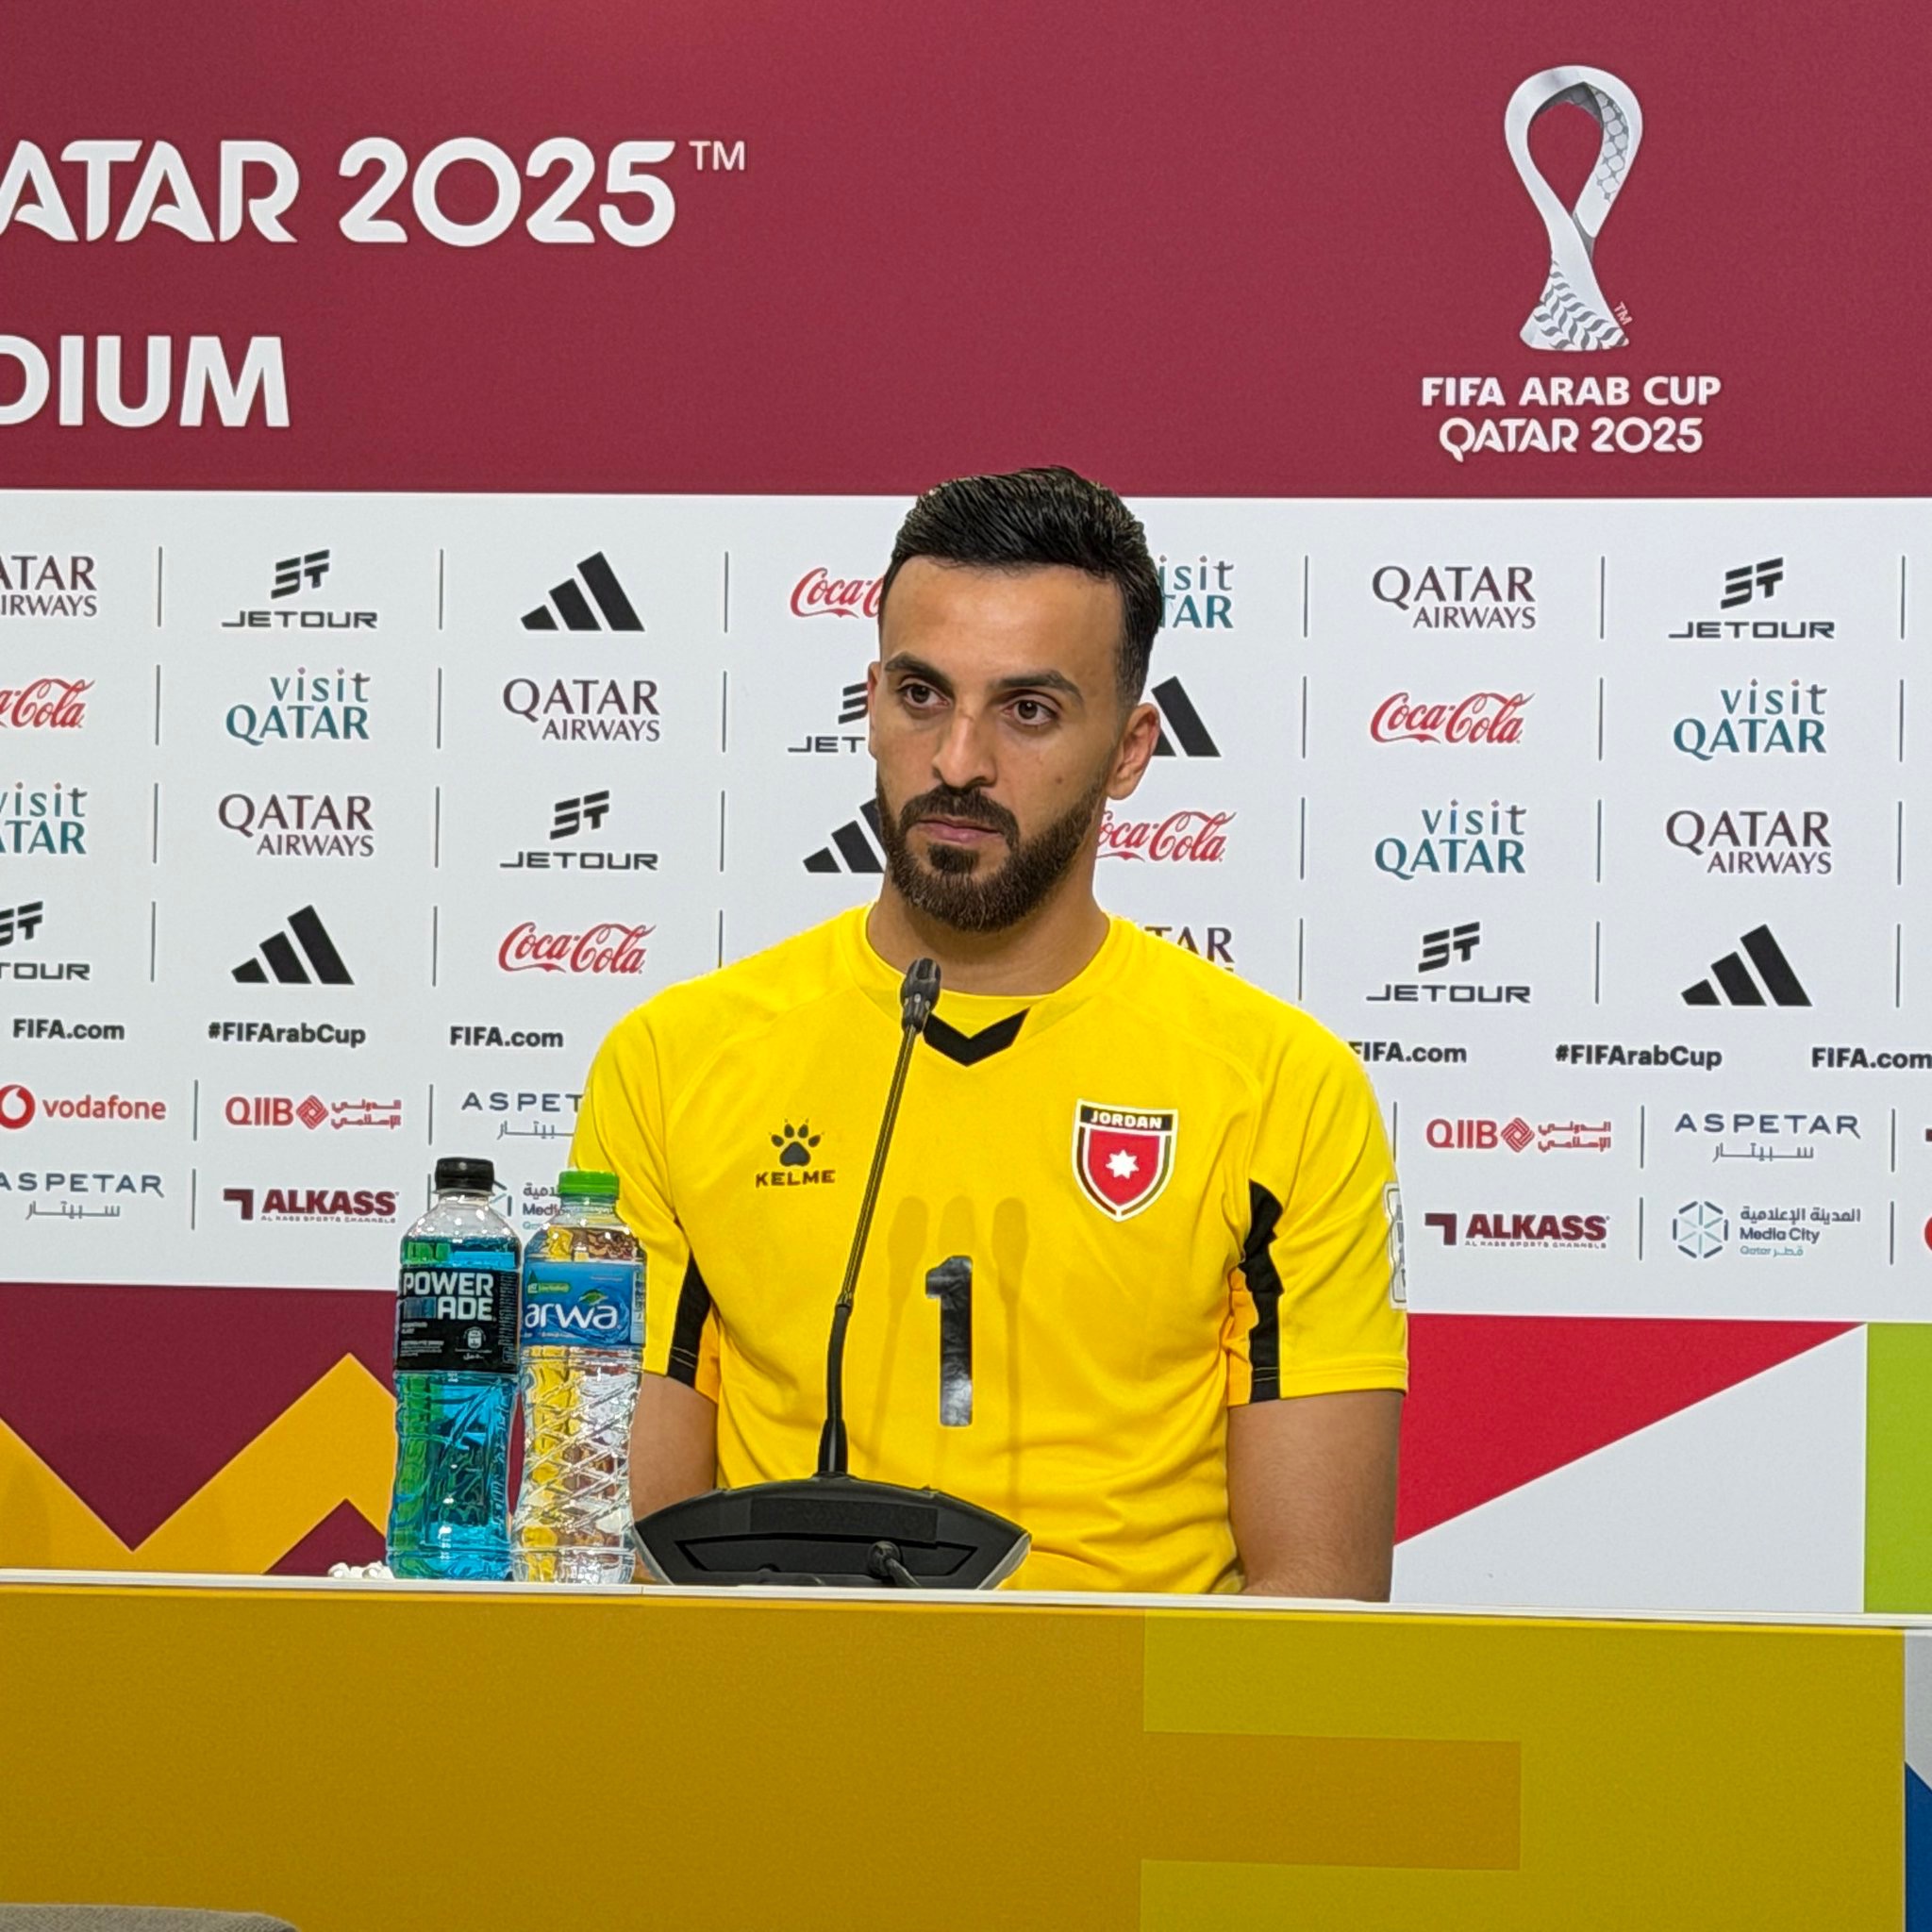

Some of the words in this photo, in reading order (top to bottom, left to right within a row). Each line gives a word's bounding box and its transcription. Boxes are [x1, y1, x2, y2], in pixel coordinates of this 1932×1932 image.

[1423, 377, 1506, 406] FIFA
[1519, 377, 1629, 406] ARAB
[1644, 376, 1721, 406] CUP
[1440, 418, 1578, 461] QATAR
[1591, 417, 1702, 453] 2025
[1158, 556, 1234, 591] isit
[1372, 565, 1536, 608] QATAR
[222, 611, 377, 628] JETOUR
[1412, 606, 1536, 629] AIRWAYS
[1669, 622, 1834, 639] JETOUR
[271, 668, 370, 702] visit
[1721, 679, 1826, 715] visit
[503, 678, 659, 722] QATAR
[226, 705, 368, 745] QATAR
[1371, 692, 1532, 743] Coca-Cola
[542, 721, 660, 741] AIRWAYS
[1674, 719, 1825, 760] QATAR
[788, 736, 865, 753] JET
[219, 794, 374, 838] QATAR
[1422, 800, 1526, 835] visit
[1097, 811, 1237, 862] oca-Cola
[1666, 809, 1831, 856] QATAR
[257, 834, 375, 858] AIRWAYS
[500, 852, 658, 870] JETOUR
[1375, 839, 1524, 880] QATAR
[1707, 851, 1832, 874] AIRWAYS
[499, 923, 655, 974] Coca-Cola
[1366, 985, 1530, 1003] JETOUR
[13, 1019, 125, 1040] FIFA.com
[208, 1023, 365, 1048] #FIFArabCup
[450, 1026, 563, 1047] FIFA.com
[1556, 1044, 1722, 1071] #FIFArabCup
[1812, 1047, 1932, 1069] FIFA.com
[42, 1095, 166, 1120] vodafone
[225, 1097, 293, 1125] QIIB
[461, 1091, 583, 1112] ASPET
[1090, 1109, 1162, 1130] JORDAN
[1675, 1114, 1860, 1139] ASPETAR
[1426, 1119, 1498, 1148] QIIB
[755, 1169, 837, 1188] KELME
[261, 1189, 397, 1216] ALKASS
[1466, 1214, 1609, 1241] ALKASS
[1740, 1227, 1786, 1241] Media
[1789, 1227, 1820, 1244] City
[403, 1271, 493, 1297] POWER
[438, 1296, 494, 1322] ADE
[525, 1303, 619, 1329] arwa
[925, 1255, 973, 1427] 1
